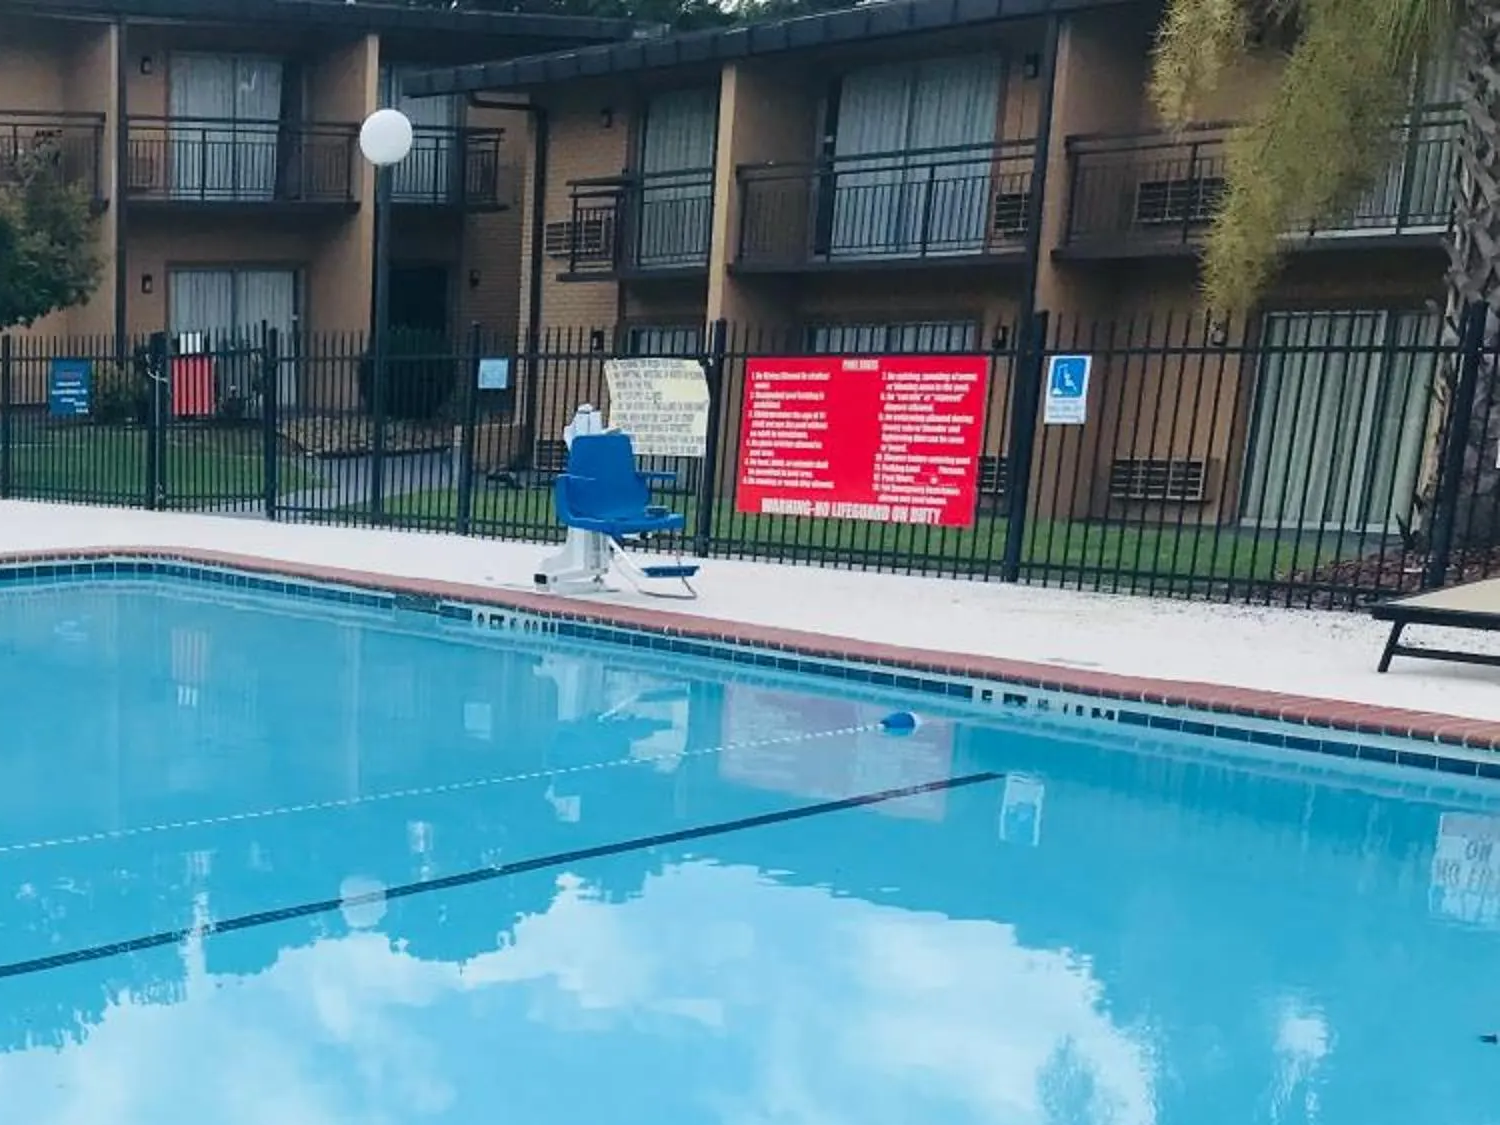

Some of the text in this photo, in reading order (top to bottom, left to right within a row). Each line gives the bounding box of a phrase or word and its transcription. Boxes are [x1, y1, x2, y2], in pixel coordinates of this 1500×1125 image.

[831, 501, 890, 521] LIFEGUARD
[892, 505, 909, 522] ON
[910, 507, 941, 524] DUTY
